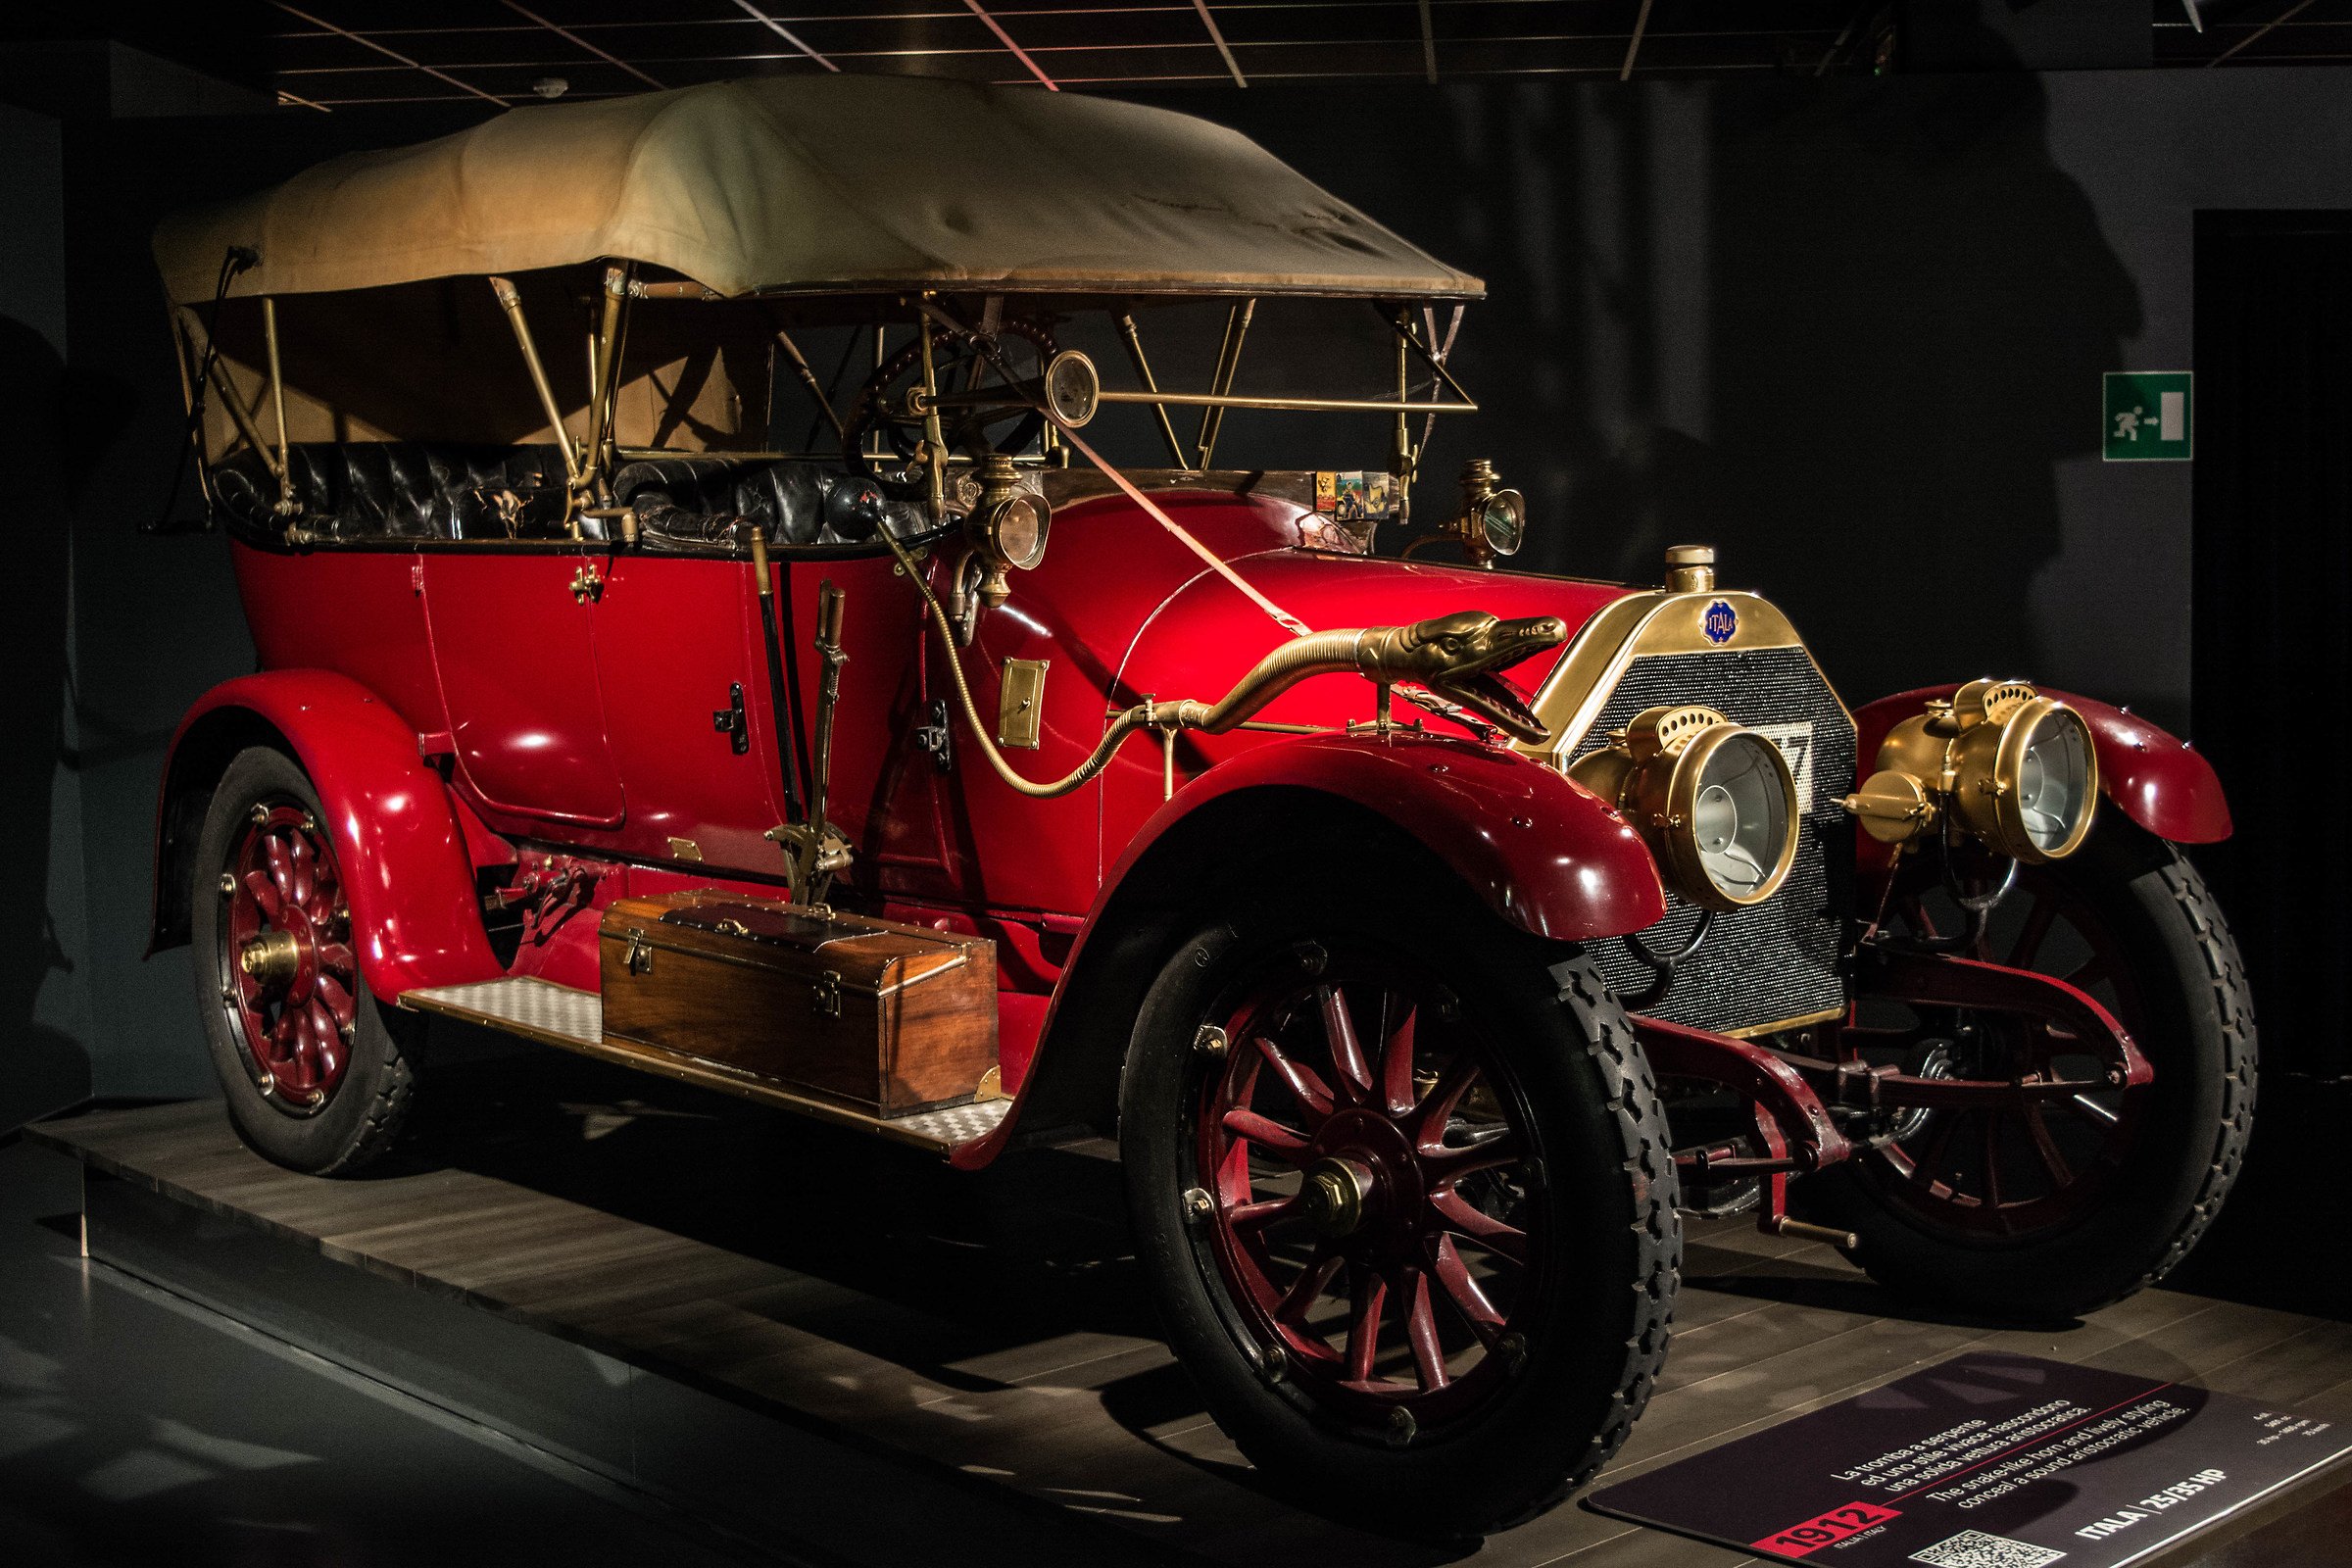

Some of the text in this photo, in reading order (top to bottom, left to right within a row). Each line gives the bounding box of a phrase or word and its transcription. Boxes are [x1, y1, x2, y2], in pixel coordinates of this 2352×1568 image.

[1708, 612, 1733, 634] ITALA
[1831, 1470, 1862, 1480] La
[1854, 1449, 1914, 1472] tromba
[1921, 1420, 1986, 1446] serpente
[1861, 1399, 2070, 1486] ed uno stile vivace nascondono
[1885, 1407, 2091, 1492] una solida vettura aristocratica.
[1926, 1399, 2171, 1501] The snake-like horn and lively styling
[1958, 1481, 2018, 1508] conceal
[2025, 1456, 2073, 1479] sound
[2068, 1427, 2142, 1460] aristocratic
[2136, 1404, 2189, 1428] vehicle.
[1776, 1509, 1884, 1547] 1912
[1834, 1535, 1861, 1549] ITALIA
[1864, 1525, 1887, 1539] ITALY
[2075, 1510, 2147, 1540] ITALA
[2139, 1482, 2205, 1510] 25/35
[2189, 1468, 2228, 1486] HP
